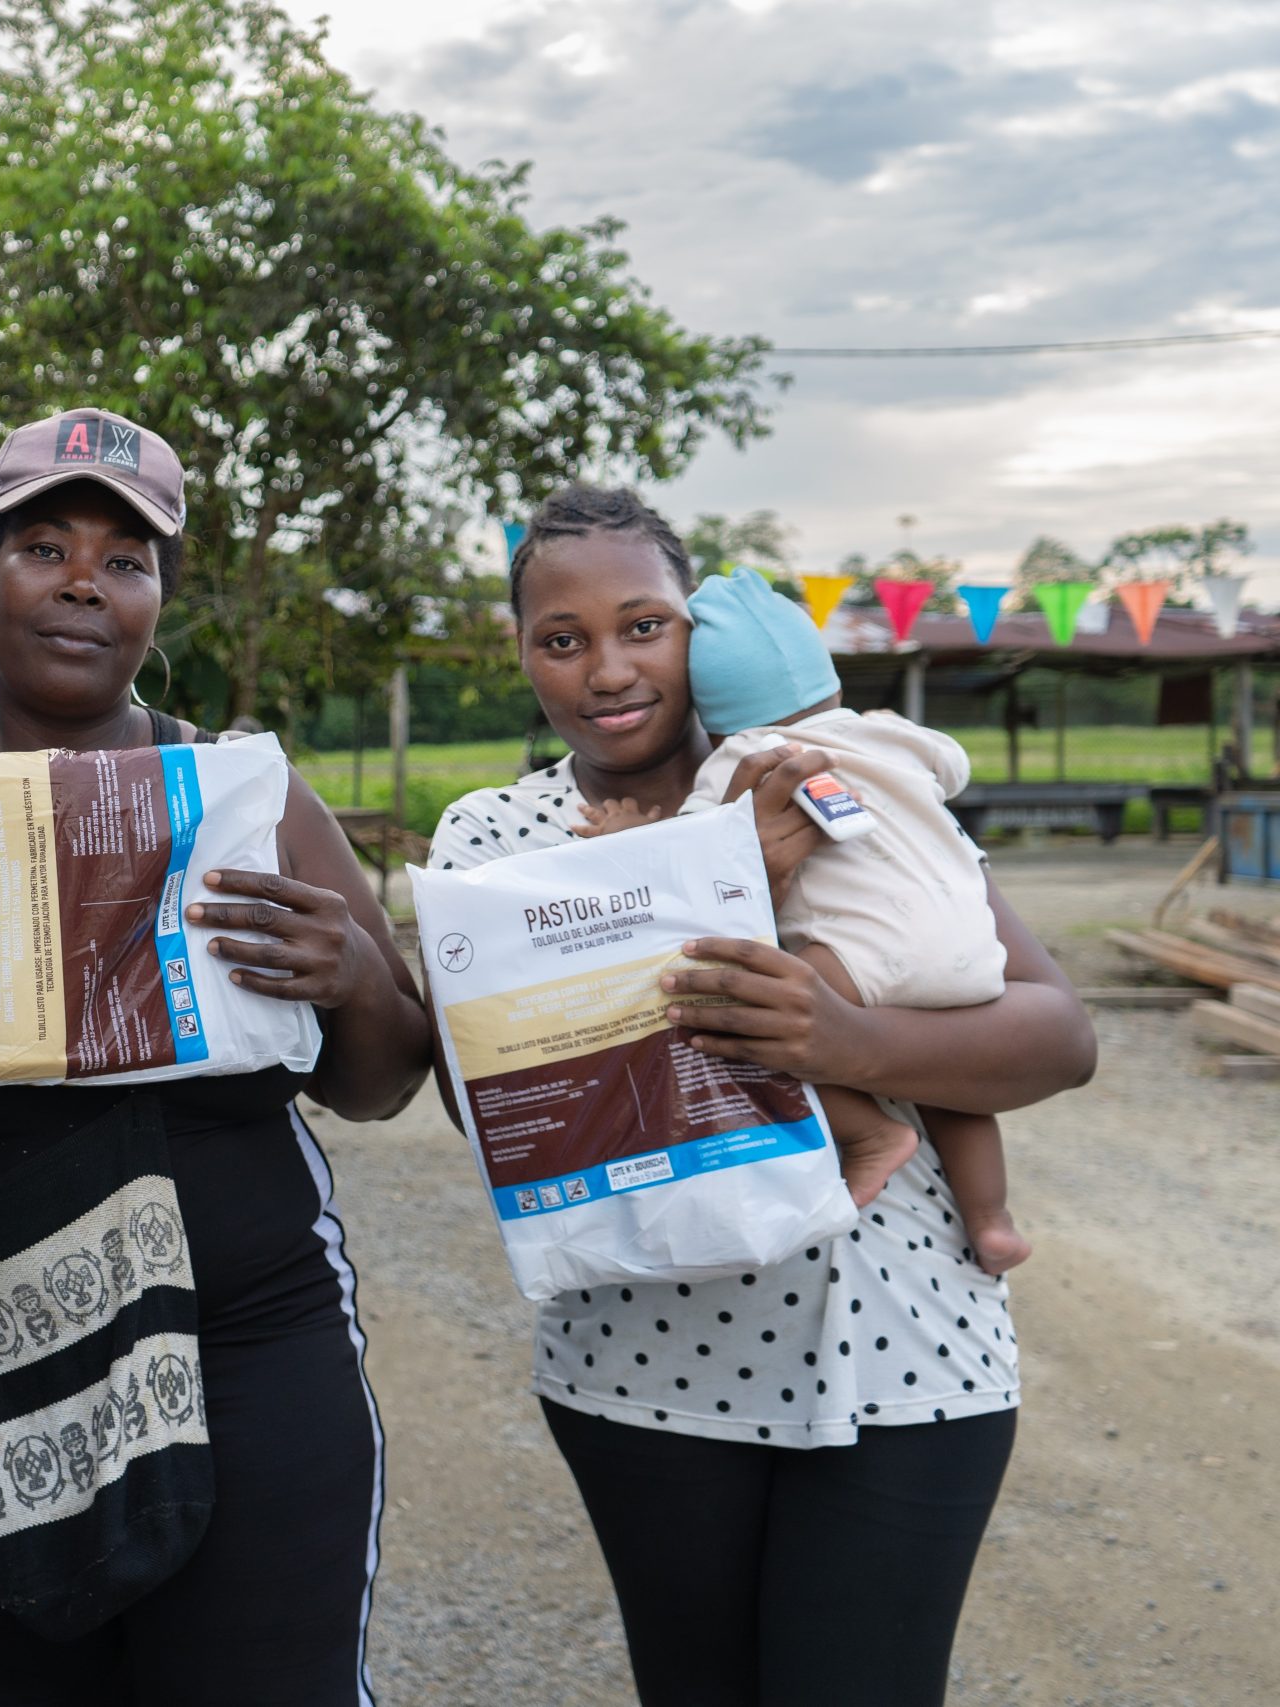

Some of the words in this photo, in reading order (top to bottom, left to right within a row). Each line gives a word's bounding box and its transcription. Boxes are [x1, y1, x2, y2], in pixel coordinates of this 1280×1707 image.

[66, 423, 90, 453] A
[109, 425, 135, 461] X
[103, 456, 138, 468] EXCHANGE
[21, 777, 30, 789] CON
[21, 790, 33, 820] POLIÉSTER
[26, 821, 34, 829] EN
[27, 830, 37, 863] FABRICADO
[38, 863, 48, 883] MAYOR
[39, 885, 49, 900] PARA
[30, 902, 40, 914] CON
[523, 893, 603, 932] PASTOR
[608, 885, 652, 913] BDU
[160, 914, 170, 930] LOTE
[531, 930, 570, 948] TOLDILLO
[570, 926, 583, 939] DE
[582, 921, 611, 936] LARGA
[611, 910, 654, 929] DURACIÓN
[31, 916, 42, 953] IMPREGNADO
[559, 944, 573, 955] USO
[574, 941, 583, 950] EN
[583, 936, 605, 948] SALUD
[605, 929, 633, 943] PÚBLICA
[44, 947, 53, 955] DE
[43, 956, 56, 992] TECNOLOGÍA
[35, 980, 45, 995] PARA
[36, 996, 46, 1012] LISTO
[36, 1013, 48, 1040] TOLDILLO
